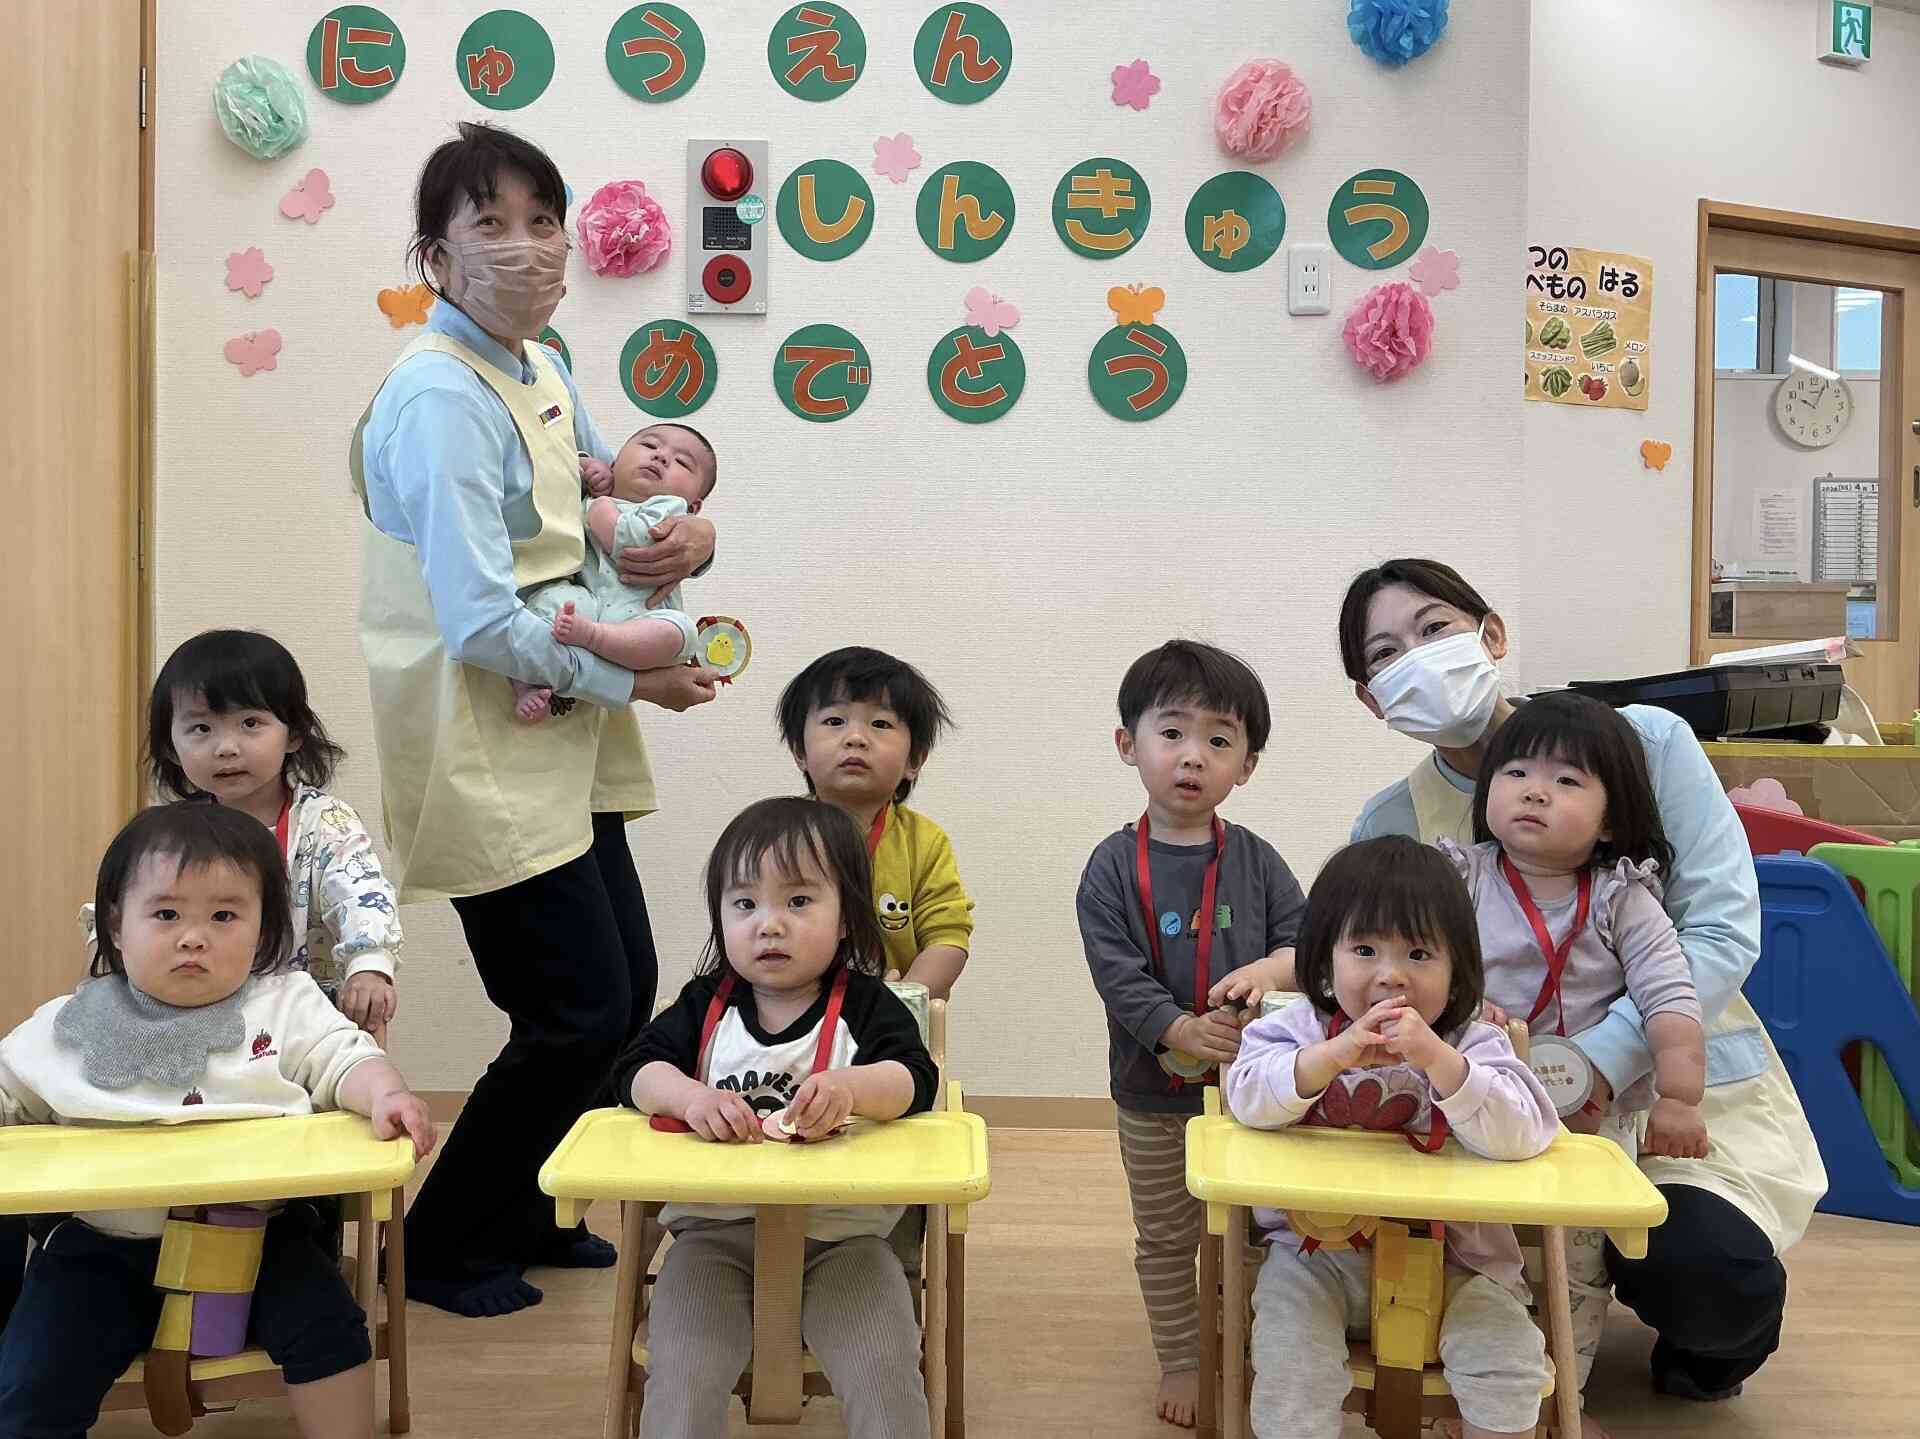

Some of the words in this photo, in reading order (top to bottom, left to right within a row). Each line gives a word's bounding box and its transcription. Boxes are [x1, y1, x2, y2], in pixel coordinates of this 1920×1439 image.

[320, 8, 1001, 96] にゅうえん
[797, 169, 1410, 261] しんきゅう
[1599, 265, 1640, 298] はる
[1538, 302, 1568, 313] そらまめ
[1574, 306, 1617, 320] アスパラガス
[1624, 341, 1647, 353] メロン
[528, 328, 1169, 415] めでとう
